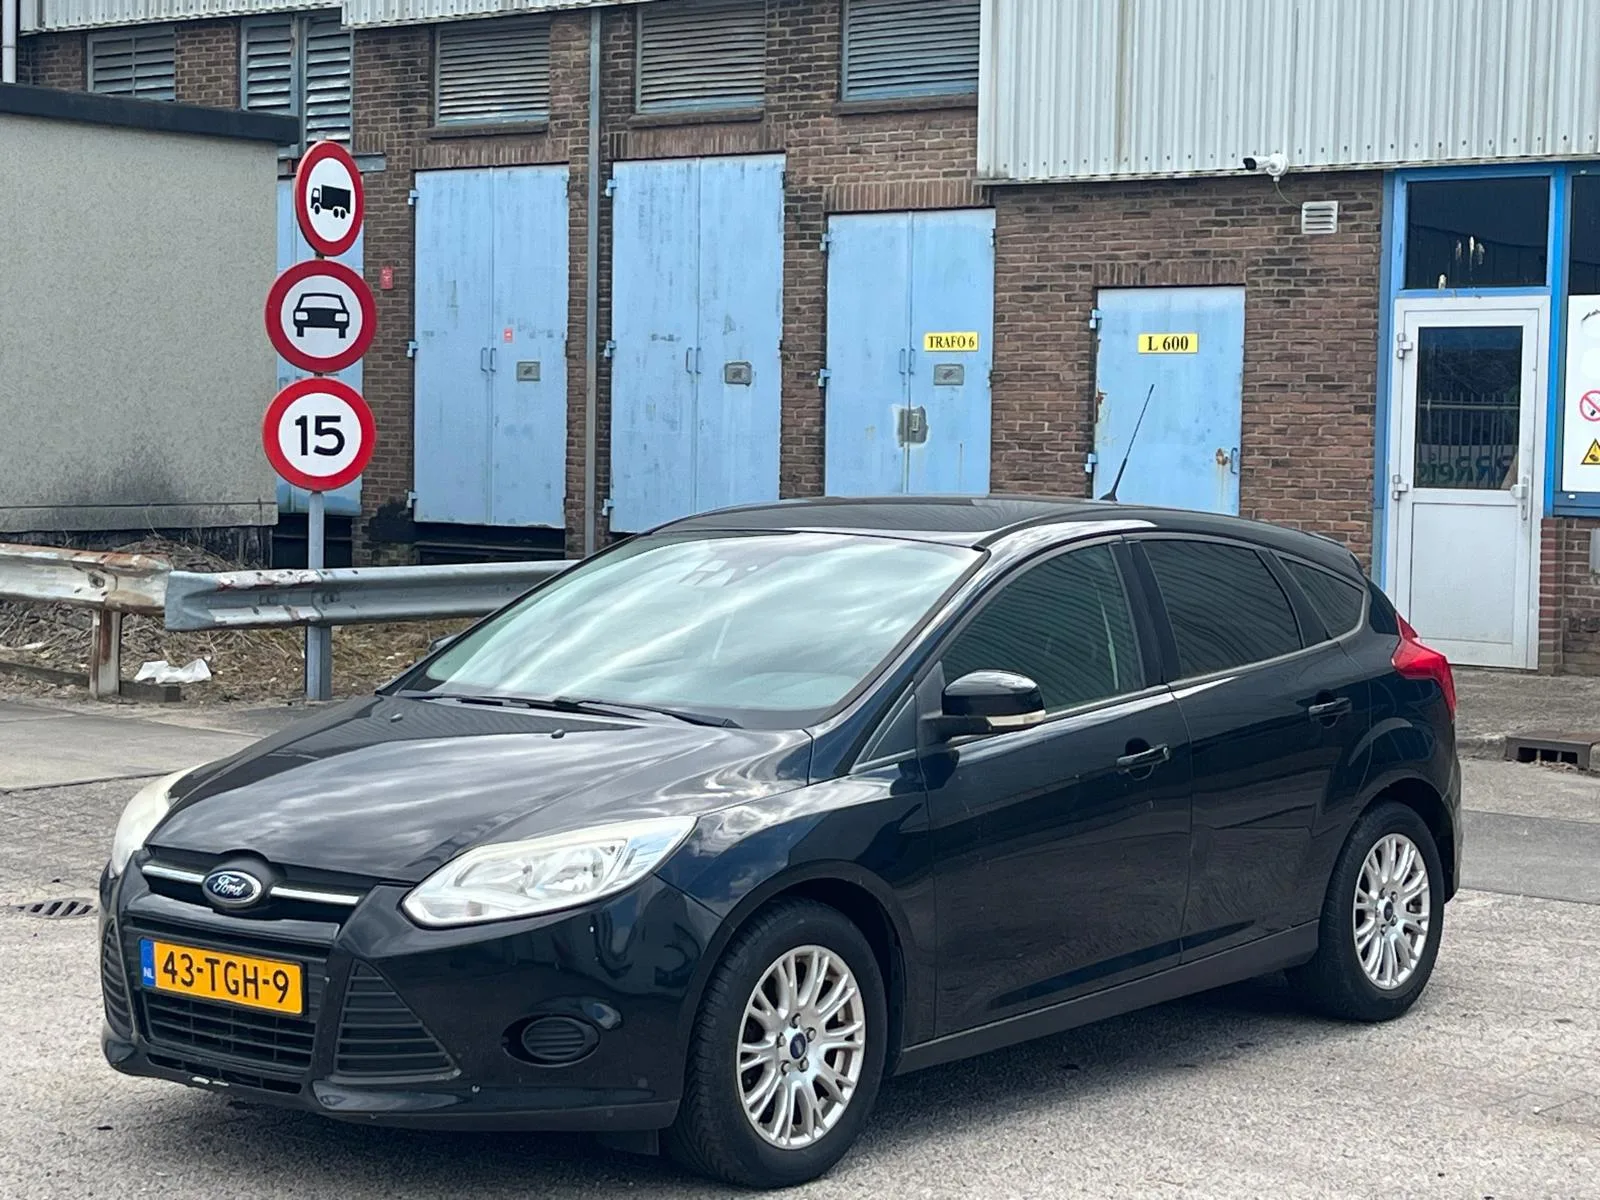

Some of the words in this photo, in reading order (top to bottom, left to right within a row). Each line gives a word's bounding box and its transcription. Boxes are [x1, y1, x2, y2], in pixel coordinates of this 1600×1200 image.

[928, 336, 965, 348] TRAFO
[969, 336, 974, 348] 6
[1147, 336, 1158, 351] L
[1163, 336, 1189, 351] 600
[295, 415, 345, 456] 15
[213, 875, 246, 896] Ford
[143, 967, 154, 979] NL
[163, 951, 289, 1003] 43-TGH-9
